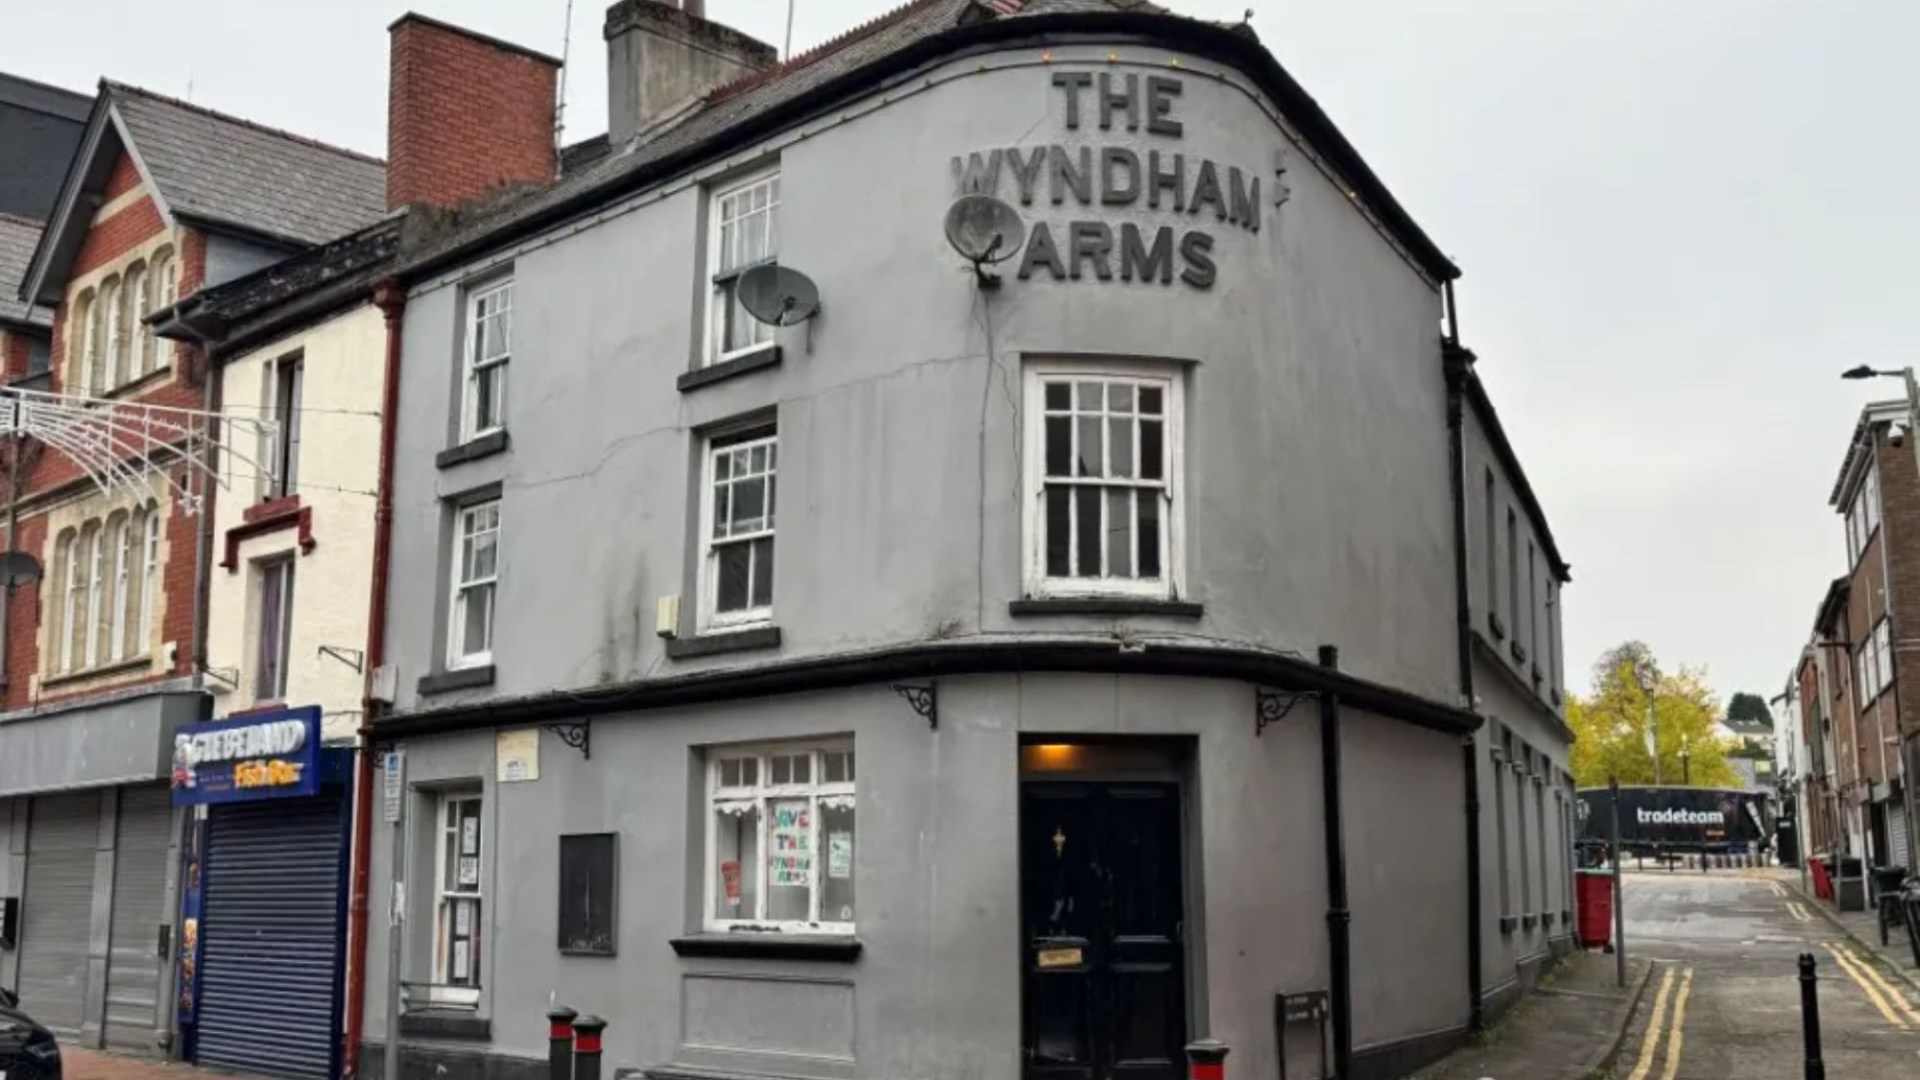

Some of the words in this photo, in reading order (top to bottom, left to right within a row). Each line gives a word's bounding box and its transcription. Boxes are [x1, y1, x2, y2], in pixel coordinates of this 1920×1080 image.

[1053, 71, 1183, 138] THE
[952, 145, 1261, 235] WYNDHAM
[1017, 220, 1217, 289] ARMS
[1637, 806, 1725, 824] tradeteam
